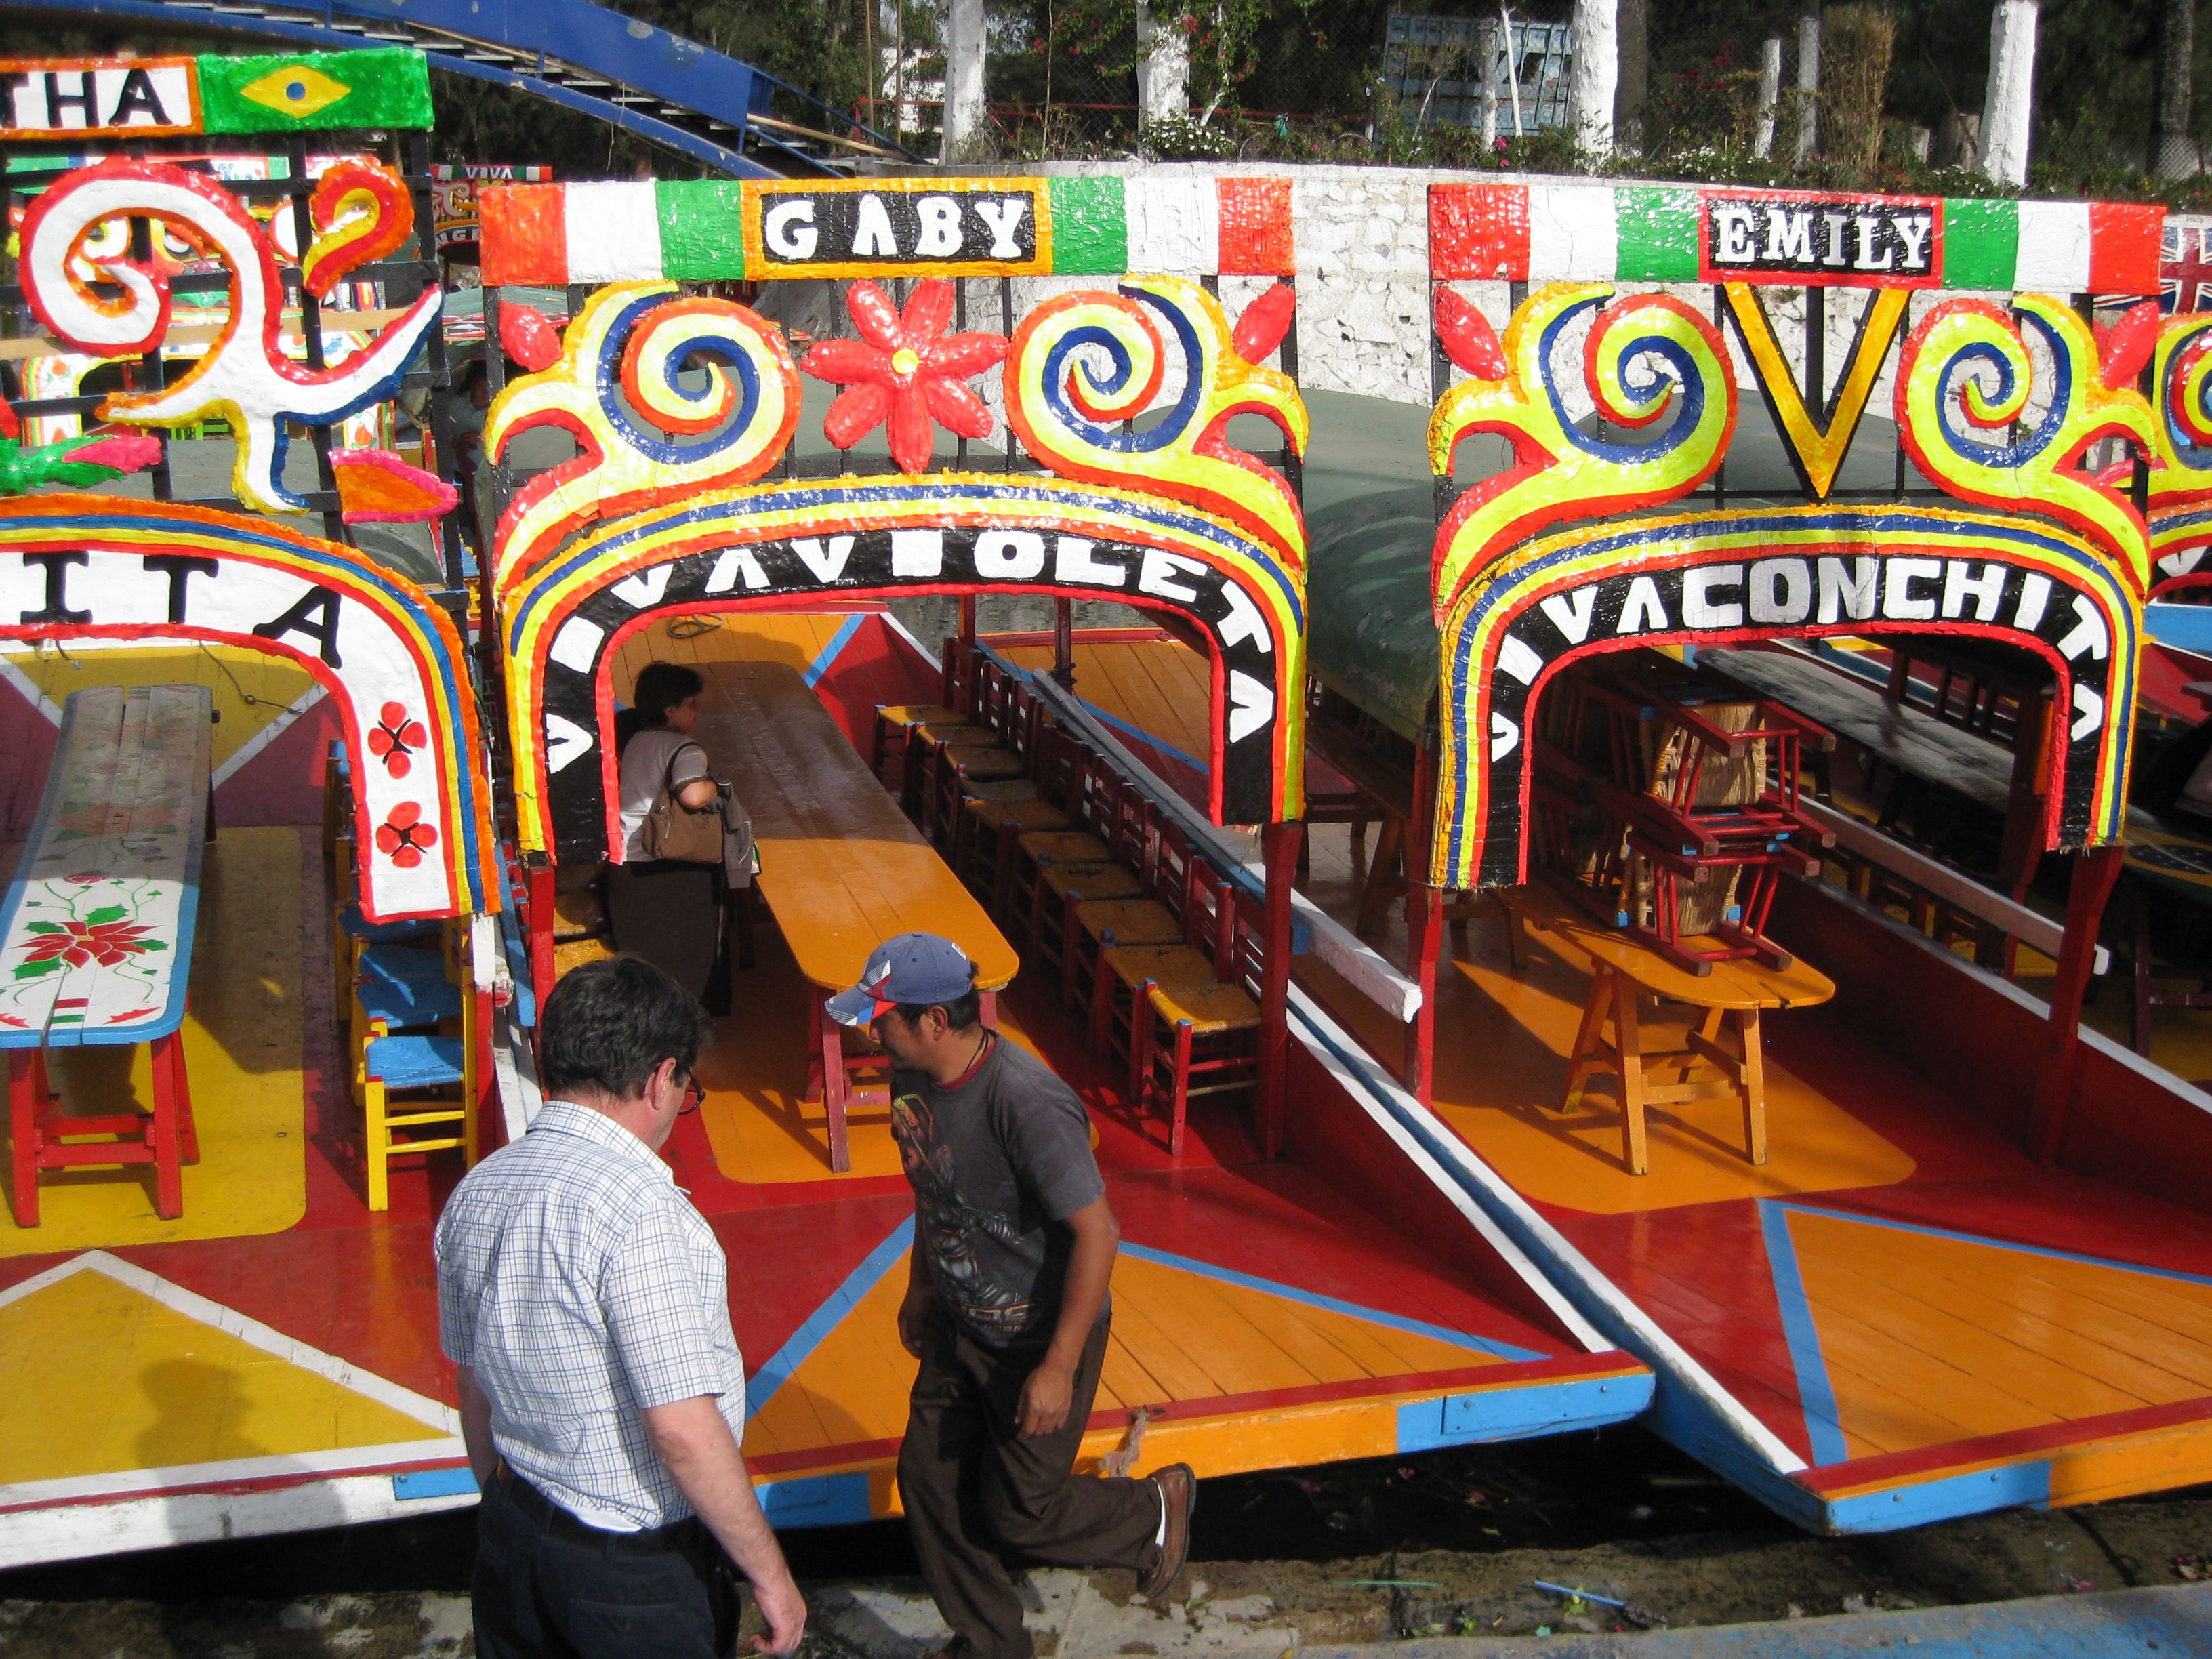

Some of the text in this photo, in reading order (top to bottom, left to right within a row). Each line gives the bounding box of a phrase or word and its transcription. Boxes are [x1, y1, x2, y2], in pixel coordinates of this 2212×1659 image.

[0, 68, 173, 129] THA
[465, 167, 514, 180] VIVA
[766, 193, 1026, 260] GABY
[1713, 209, 1931, 270] EMILY
[20, 550, 343, 670] ITA
[546, 530, 1274, 775] VIVA VIOLETA
[1492, 556, 2108, 763] VIVA CONCHITA
